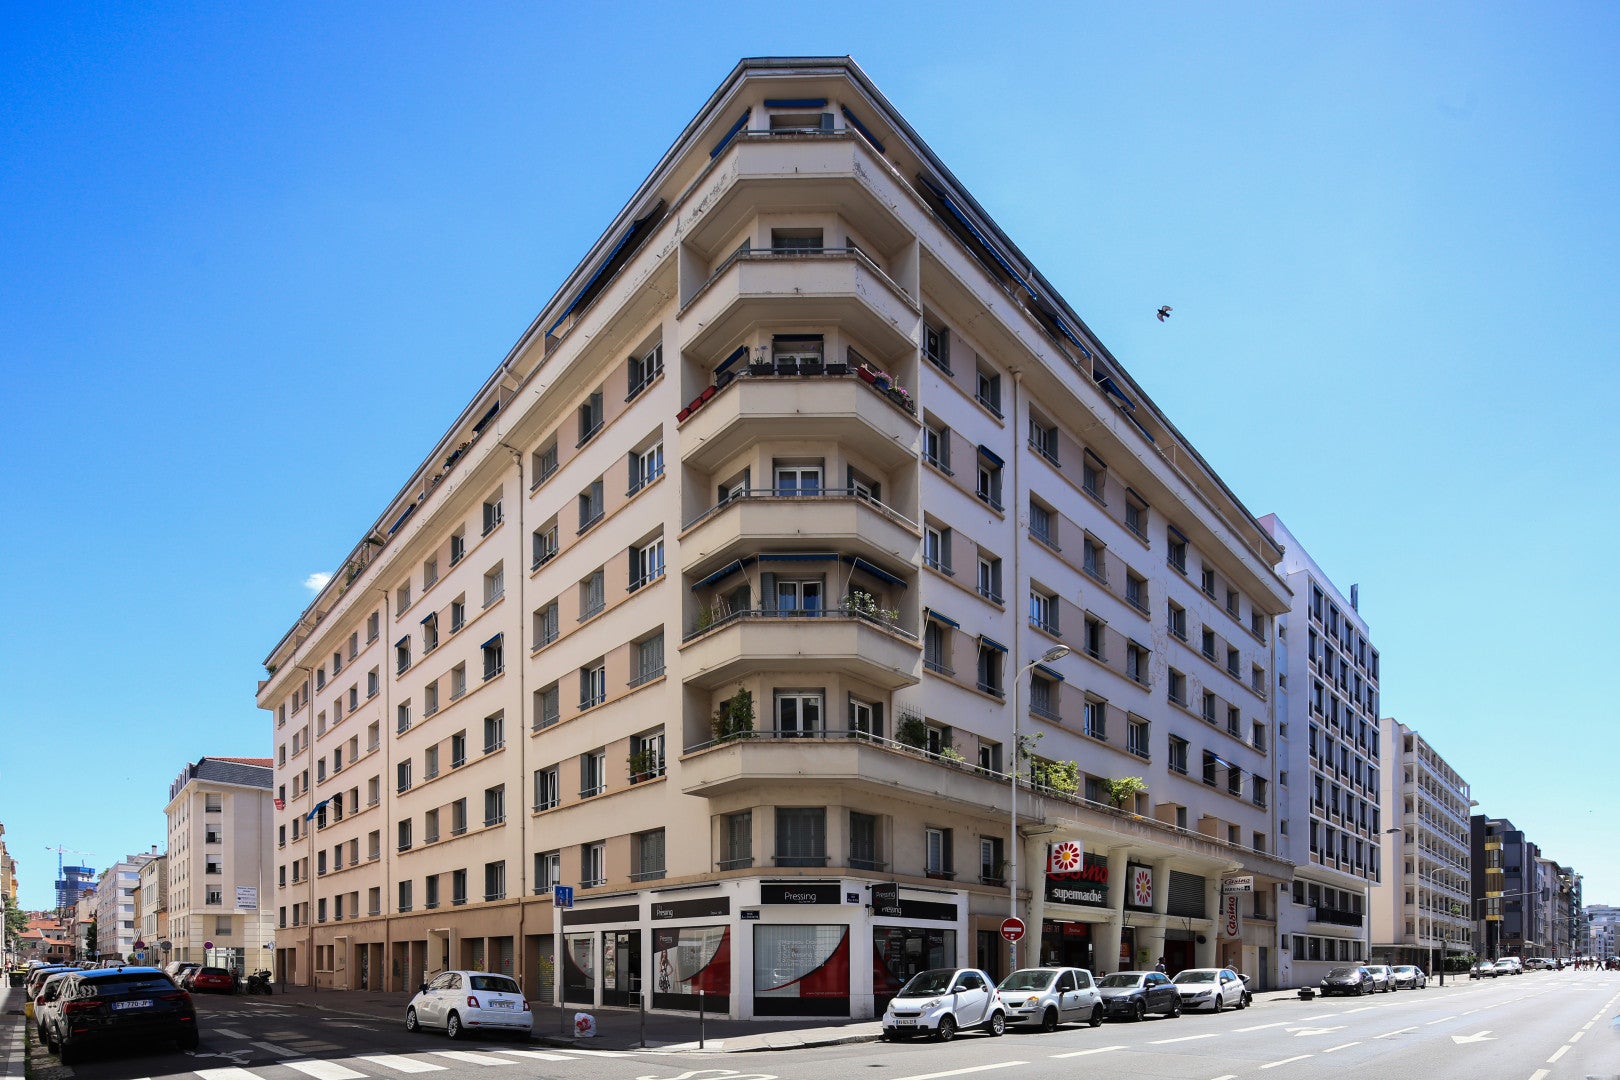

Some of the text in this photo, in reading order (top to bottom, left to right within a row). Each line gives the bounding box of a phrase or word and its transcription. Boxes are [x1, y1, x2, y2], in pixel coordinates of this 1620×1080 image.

[784, 891, 817, 903] Pressing
[875, 891, 896, 900] Pressing
[1053, 888, 1102, 903] supermarché
[656, 909, 674, 918] Pressing
[1226, 896, 1238, 937] Casino
